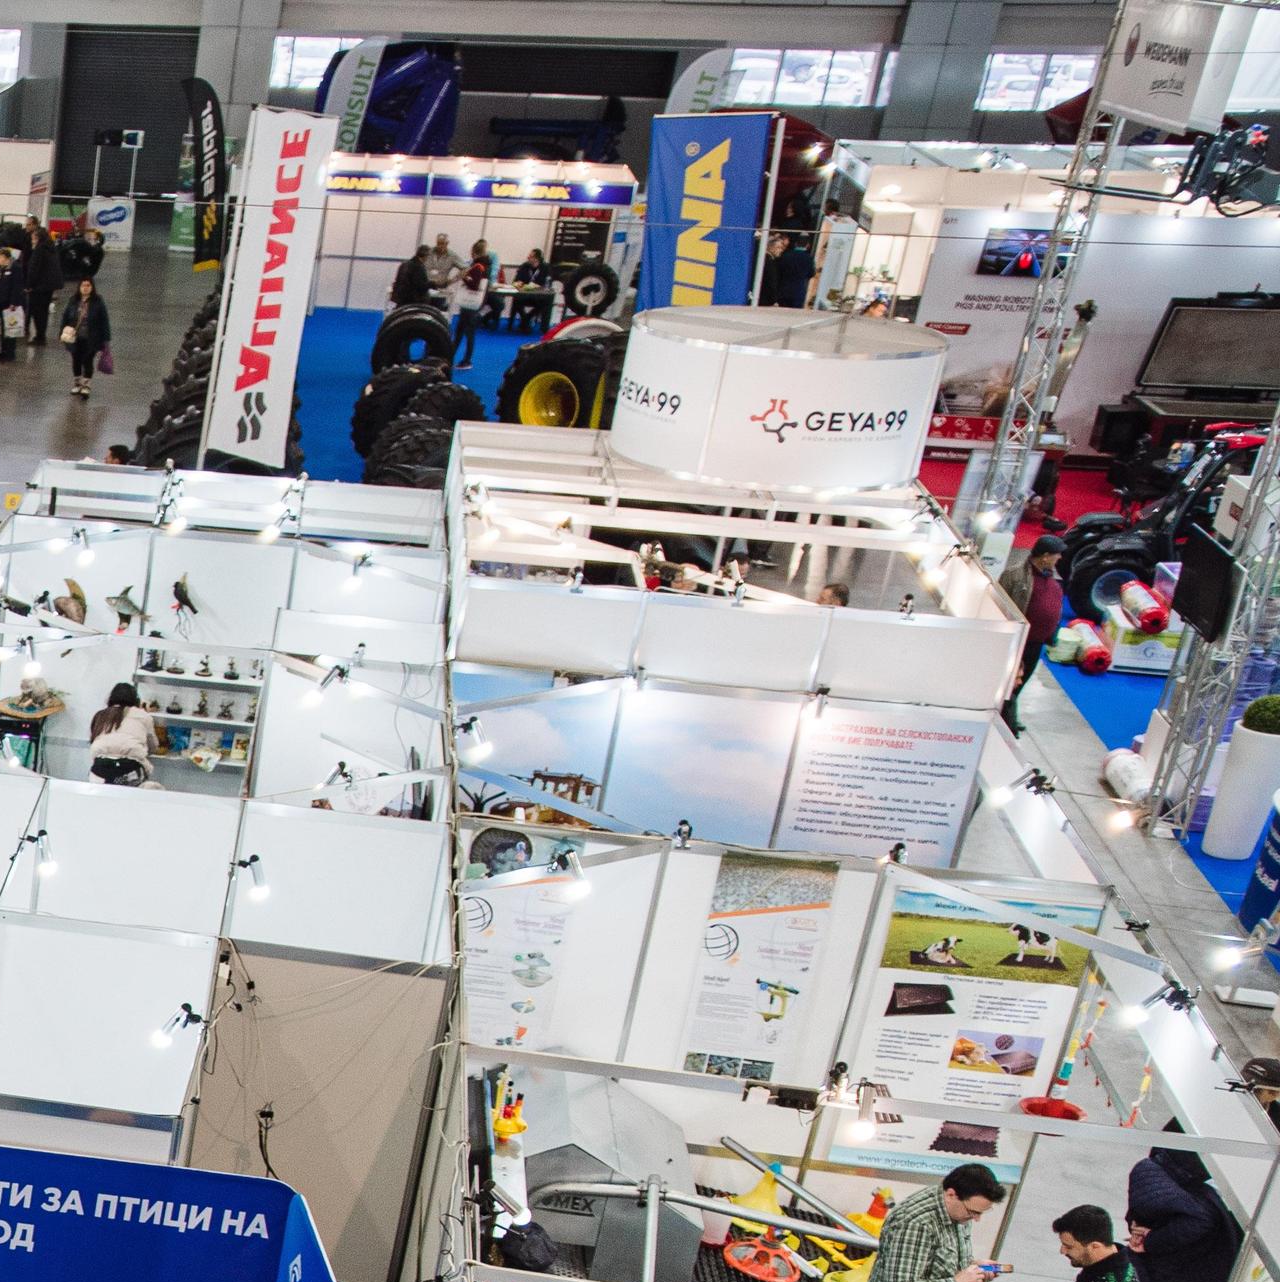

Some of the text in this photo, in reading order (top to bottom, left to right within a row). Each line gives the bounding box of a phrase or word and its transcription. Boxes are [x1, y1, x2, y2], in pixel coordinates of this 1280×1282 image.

[235, 128, 311, 391] ALLIANCE
[41, 1186, 84, 1216] ЗА
[94, 1193, 212, 1233] ПТИЦИ
[220, 1209, 270, 1240] НА
